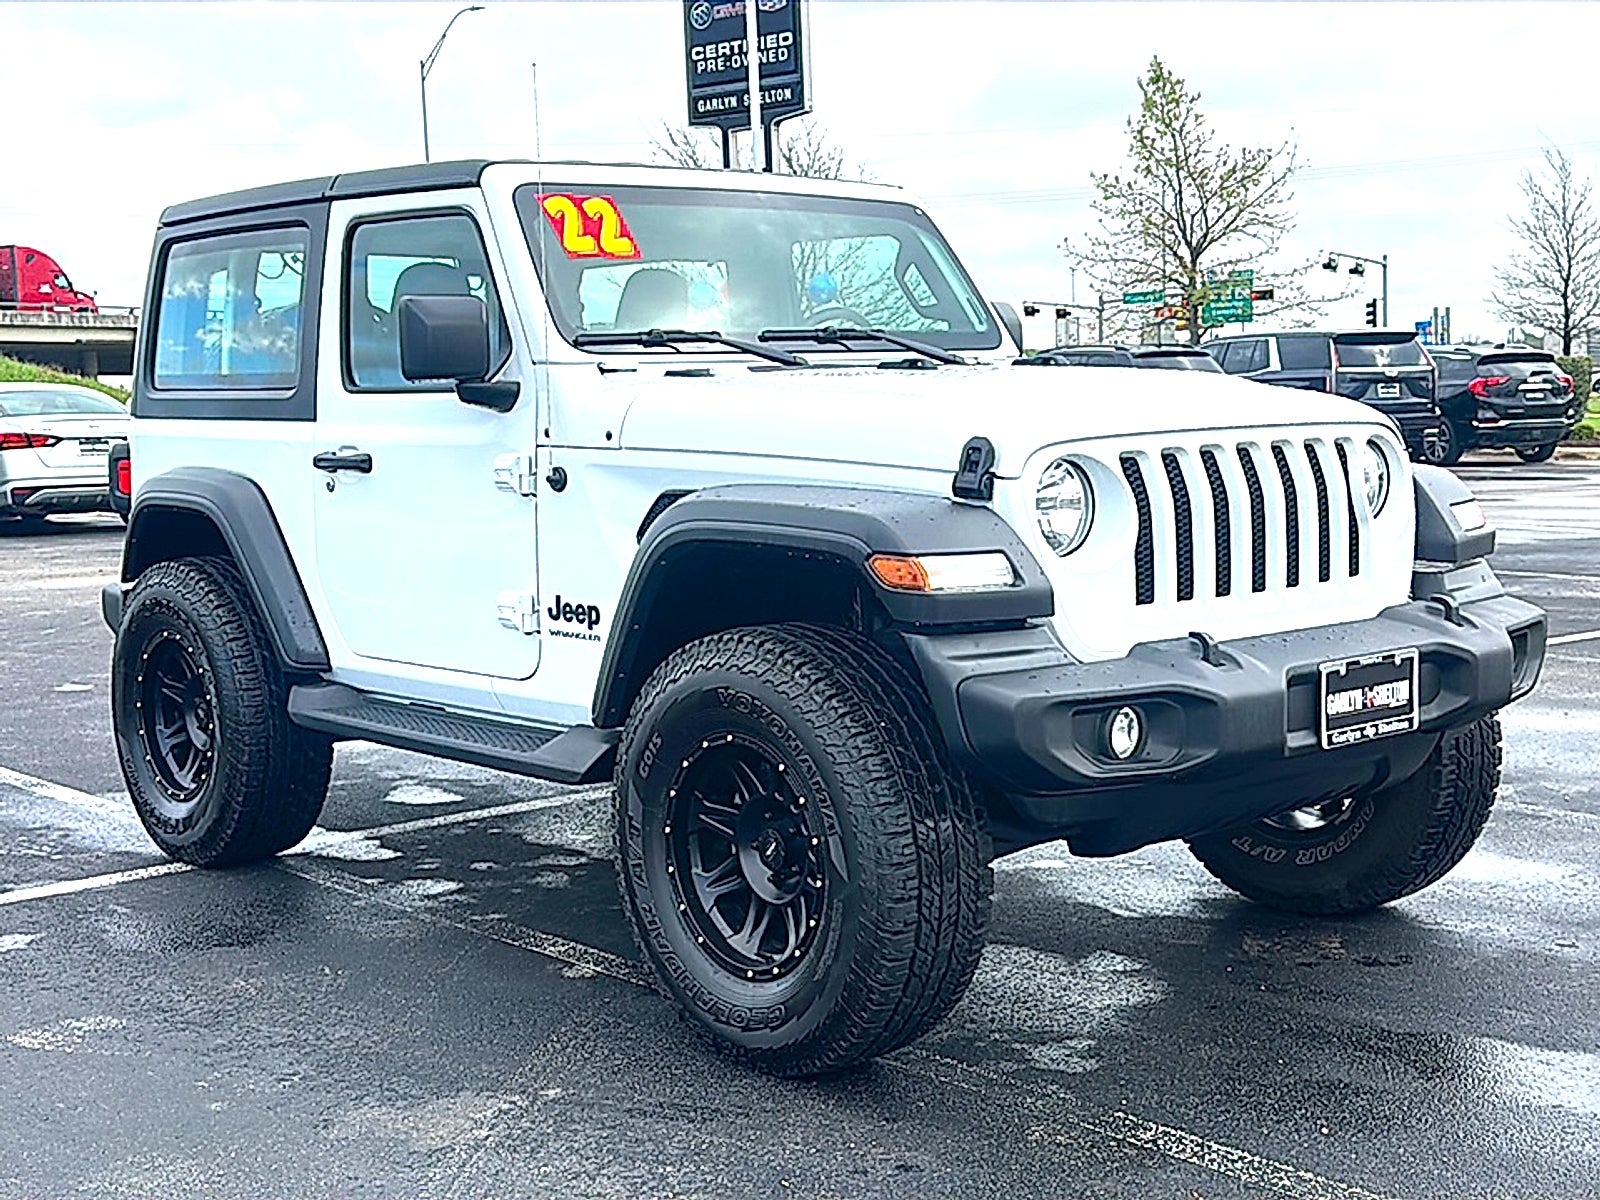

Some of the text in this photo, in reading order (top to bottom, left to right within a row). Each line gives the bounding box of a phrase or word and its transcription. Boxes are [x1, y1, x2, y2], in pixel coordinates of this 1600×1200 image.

[691, 32, 794, 61] CERTIIED
[697, 88, 792, 113] GARLYN SELTON
[542, 195, 635, 257] 22
[547, 594, 601, 631] Jeep
